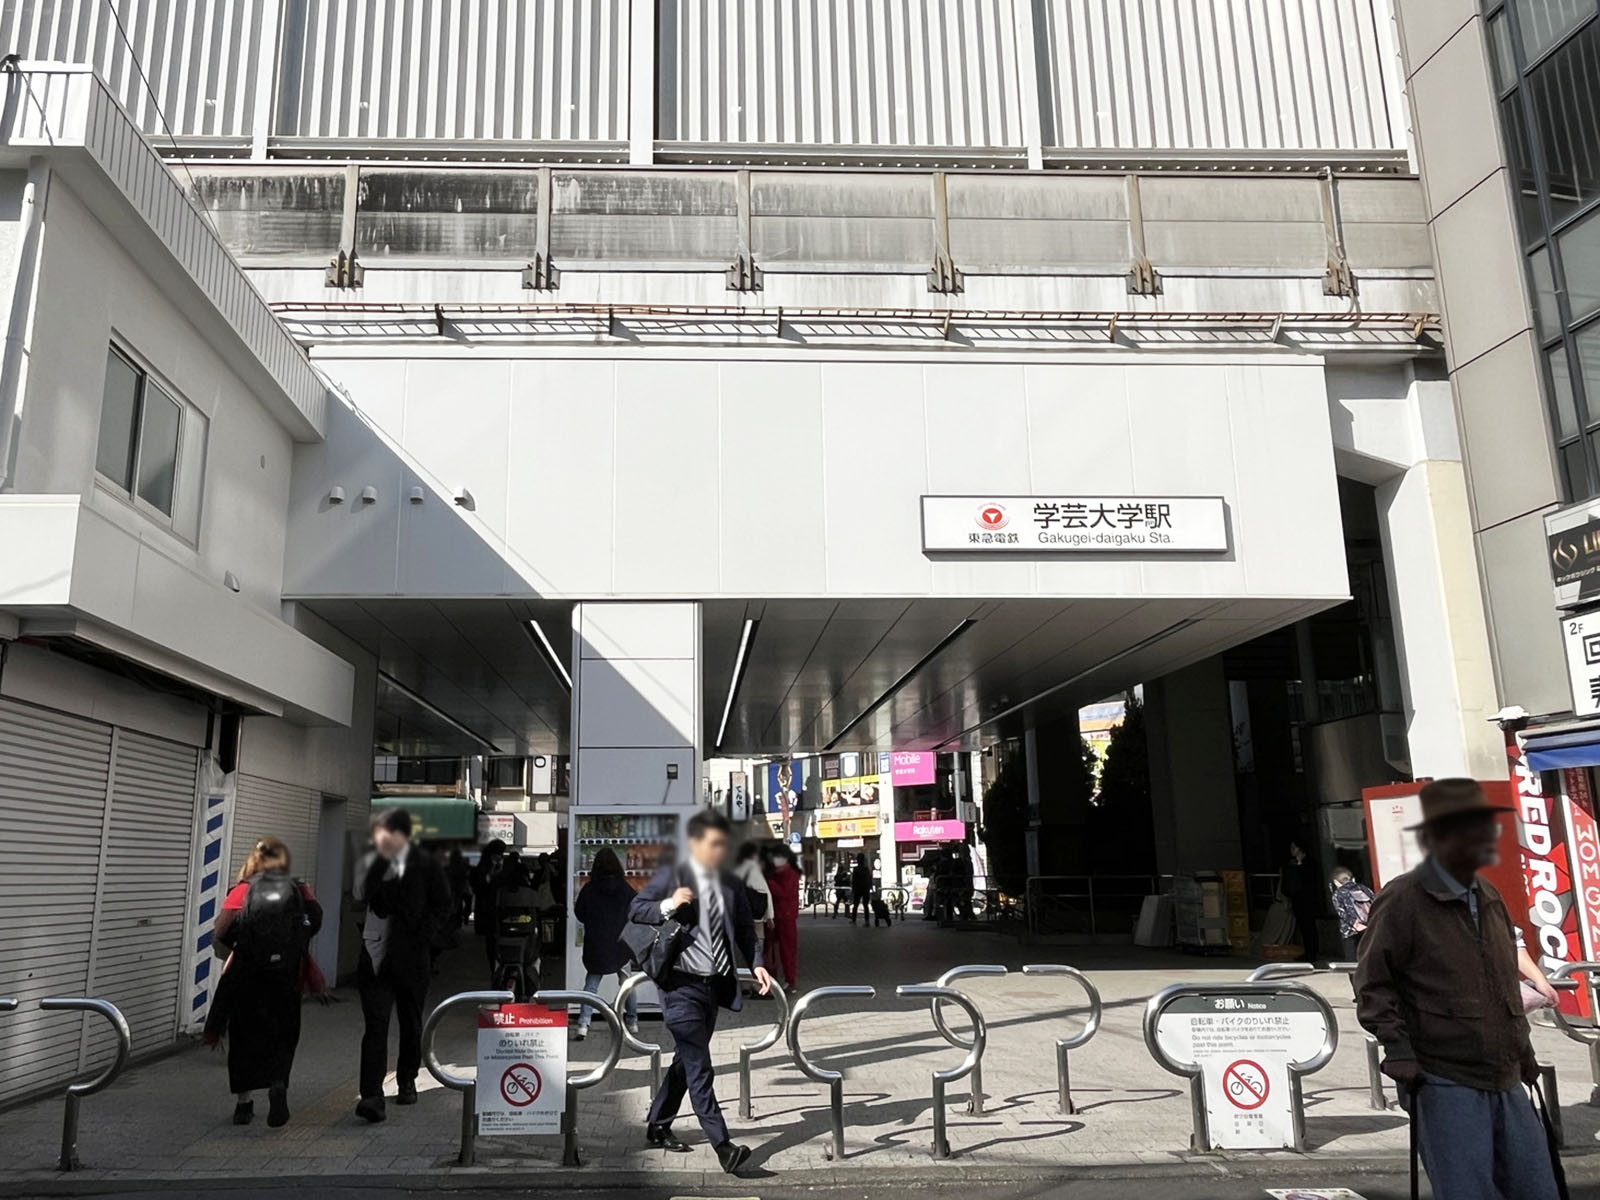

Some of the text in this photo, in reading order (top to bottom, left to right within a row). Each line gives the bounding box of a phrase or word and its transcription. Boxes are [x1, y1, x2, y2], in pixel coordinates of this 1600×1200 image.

[1033, 502, 1172, 529] 学芸大学駅
[968, 532, 1020, 544] 東急電鉄
[1038, 531, 1174, 546] Gakugei-daigaku Sta.
[1583, 529, 1600, 554] LI
[1569, 622, 1584, 636] 2F
[894, 753, 921, 765] Mobile
[912, 825, 944, 835] Rakuten
[1247, 1002, 1267, 1010] Notice
[493, 1012, 554, 1025] 禁止 Prohibition
